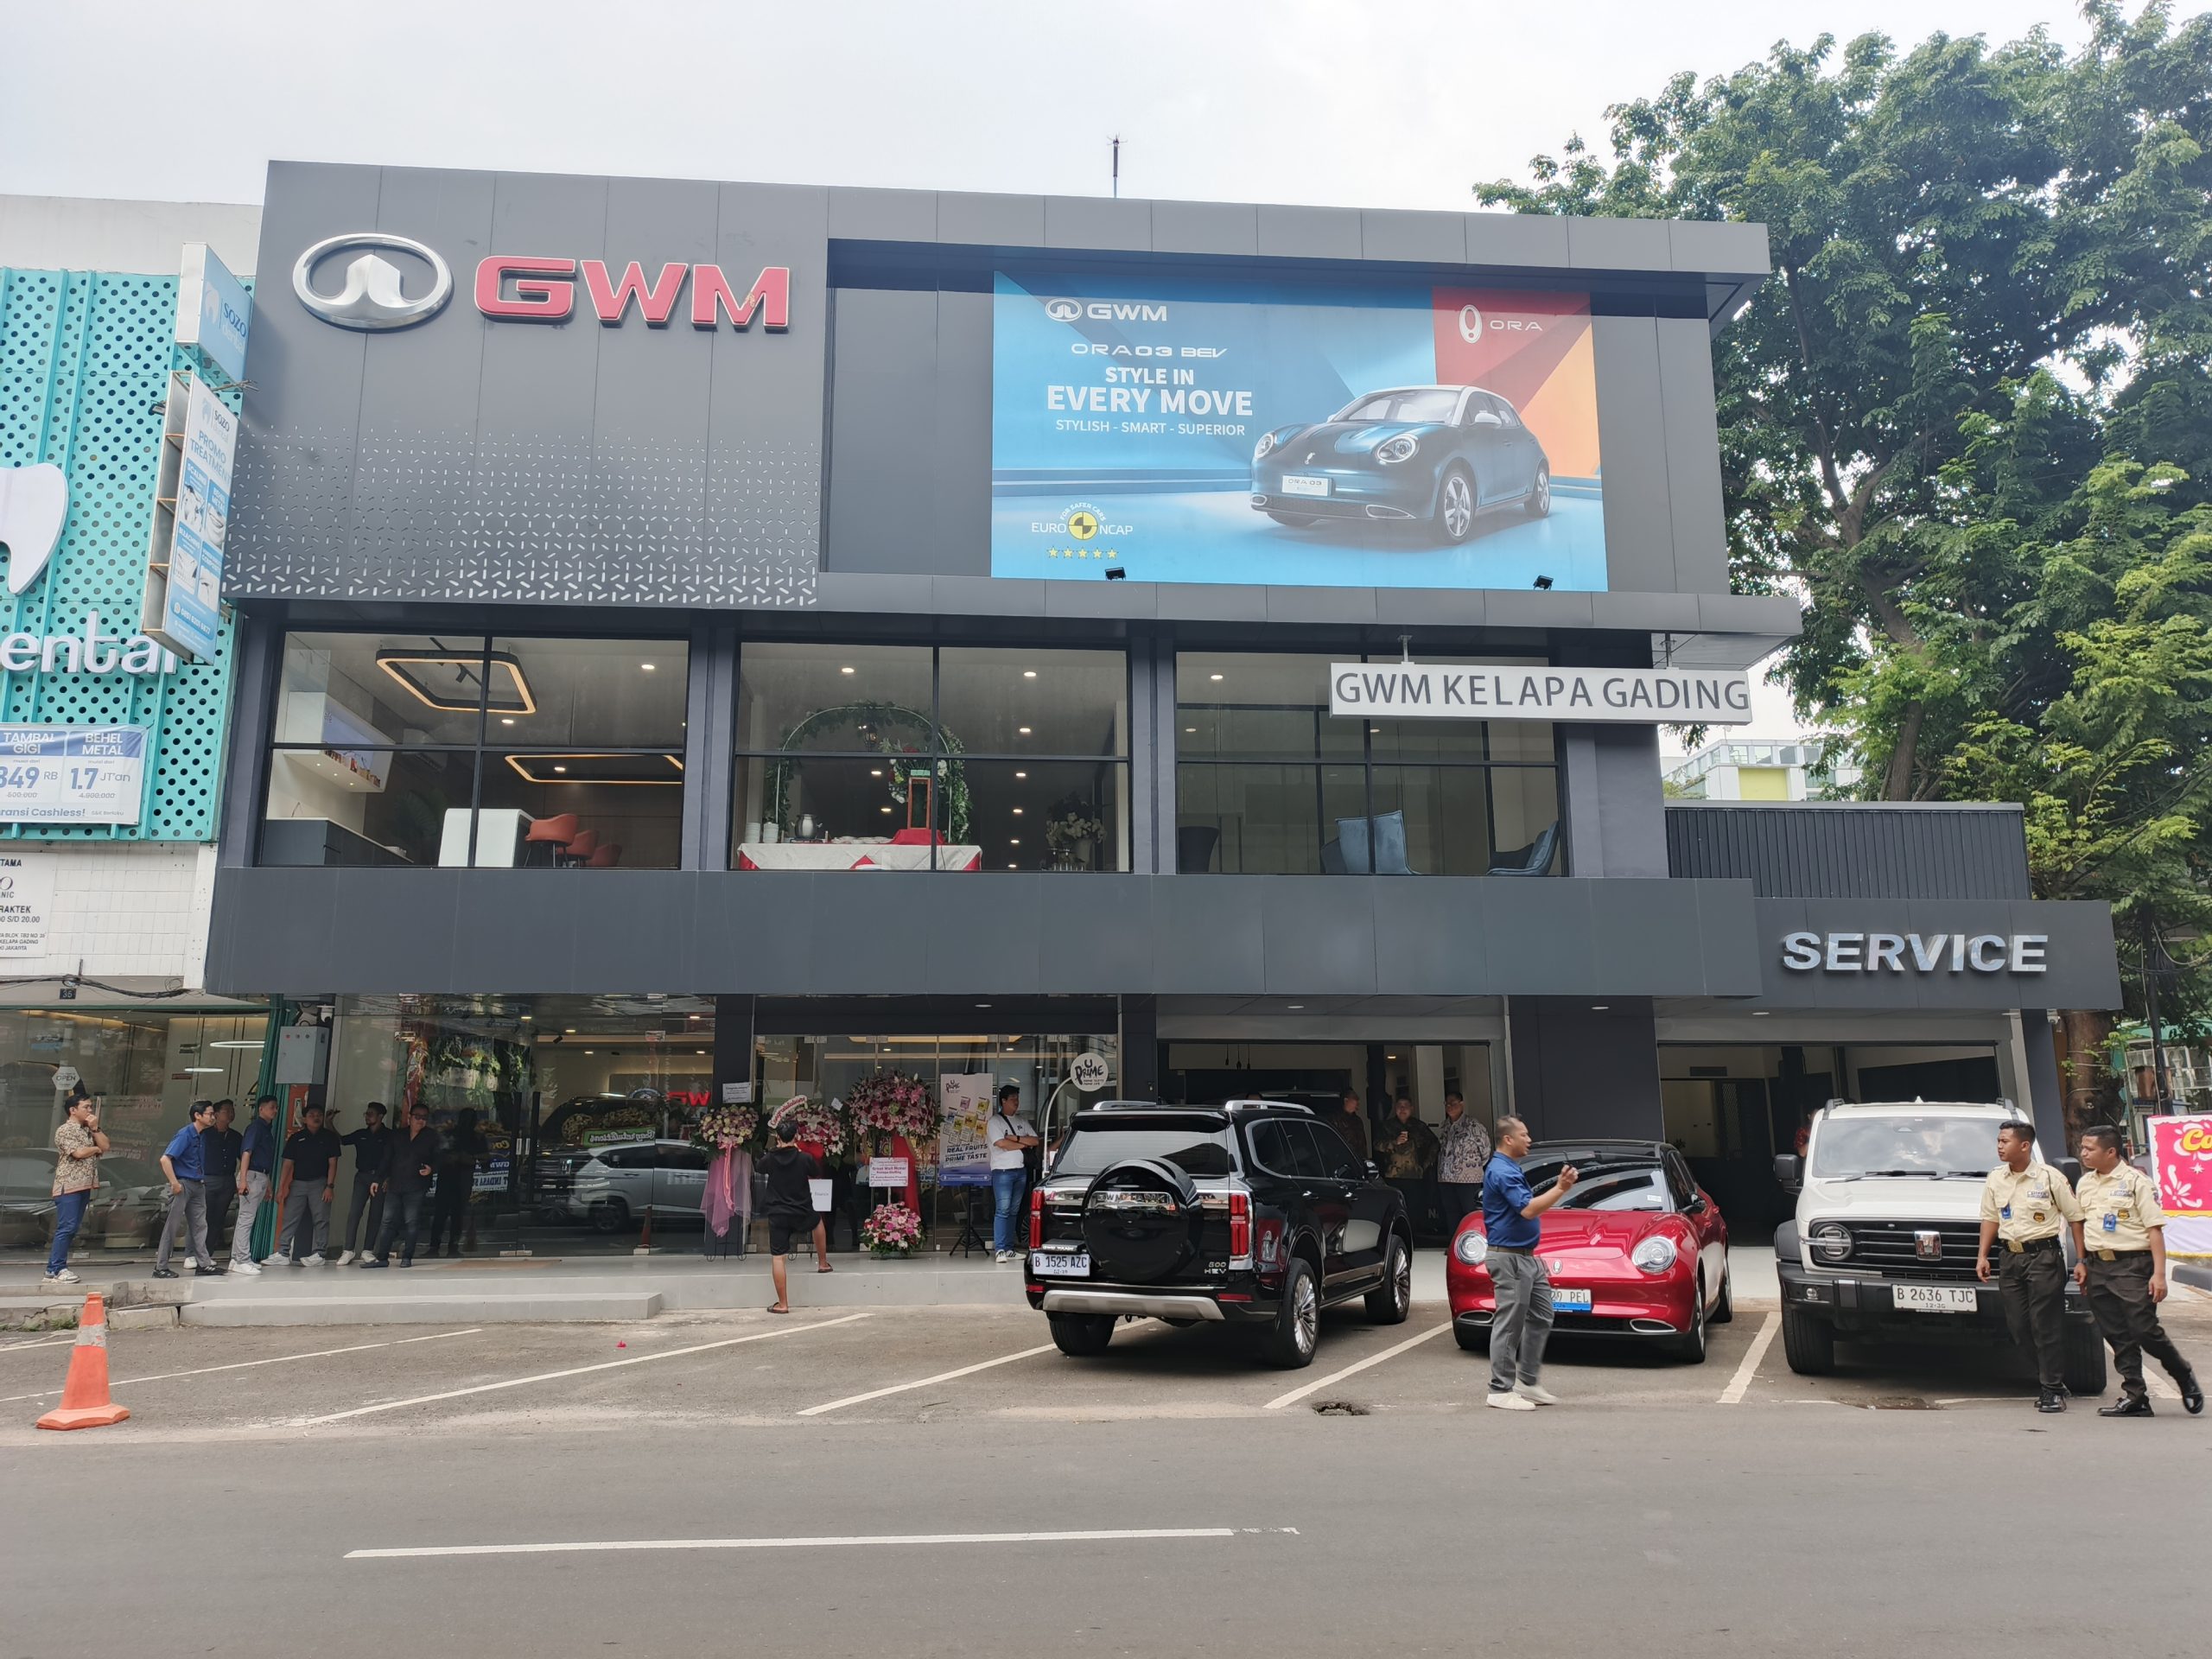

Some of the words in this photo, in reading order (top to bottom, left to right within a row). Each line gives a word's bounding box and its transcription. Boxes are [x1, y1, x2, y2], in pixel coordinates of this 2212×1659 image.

[474, 255, 790, 327] GWM
[1087, 303, 1166, 321] GWM
[224, 302, 247, 338] SOZO
[1490, 320, 1542, 331] ORA
[1181, 347, 1228, 358] BEV
[1105, 366, 1166, 385] STYLE
[1173, 369, 1193, 385] IN
[1047, 385, 1151, 414] EVERY
[1160, 390, 1253, 416] MOVE
[213, 410, 230, 432] SOZO
[1056, 419, 1109, 433] STYLISH
[1121, 422, 1166, 434] SMART
[1178, 423, 1245, 436] SUPERIOR
[199, 429, 226, 464] PROMO
[1070, 502, 1091, 511] SAFER
[1092, 505, 1107, 522] CARS
[1031, 522, 1067, 534] EURO
[1099, 524, 1134, 535] NCAP
[1335, 672, 1432, 705] GWM
[1443, 674, 1594, 708] KELAPA
[1603, 677, 1750, 711] GADING
[3, 732, 55, 743] TAMBAL
[85, 732, 123, 744] BEHEL
[13, 743, 41, 754] GIGI
[82, 744, 124, 755] METAL
[43, 771, 59, 780] RB
[71, 767, 99, 790] 1.7
[0, 807, 29, 817] ransi
[31, 808, 86, 817] Cashless!
[1782, 931, 2049, 973] SERVICE
[61, 990, 73, 999] 35
[1075, 1065, 1103, 1085] PRIME
[964, 1143, 988, 1152] FRUITS
[967, 1152, 988, 1160] TASTE
[1034, 1255, 1040, 1268] B
[1046, 1255, 1068, 1268] 1525
[1070, 1256, 1088, 1268] AZC
[1570, 1291, 1589, 1303] PEL
[1897, 1287, 1904, 1300] B
[1910, 1288, 1942, 1301] 2636
[1949, 1290, 1974, 1303] TJC
